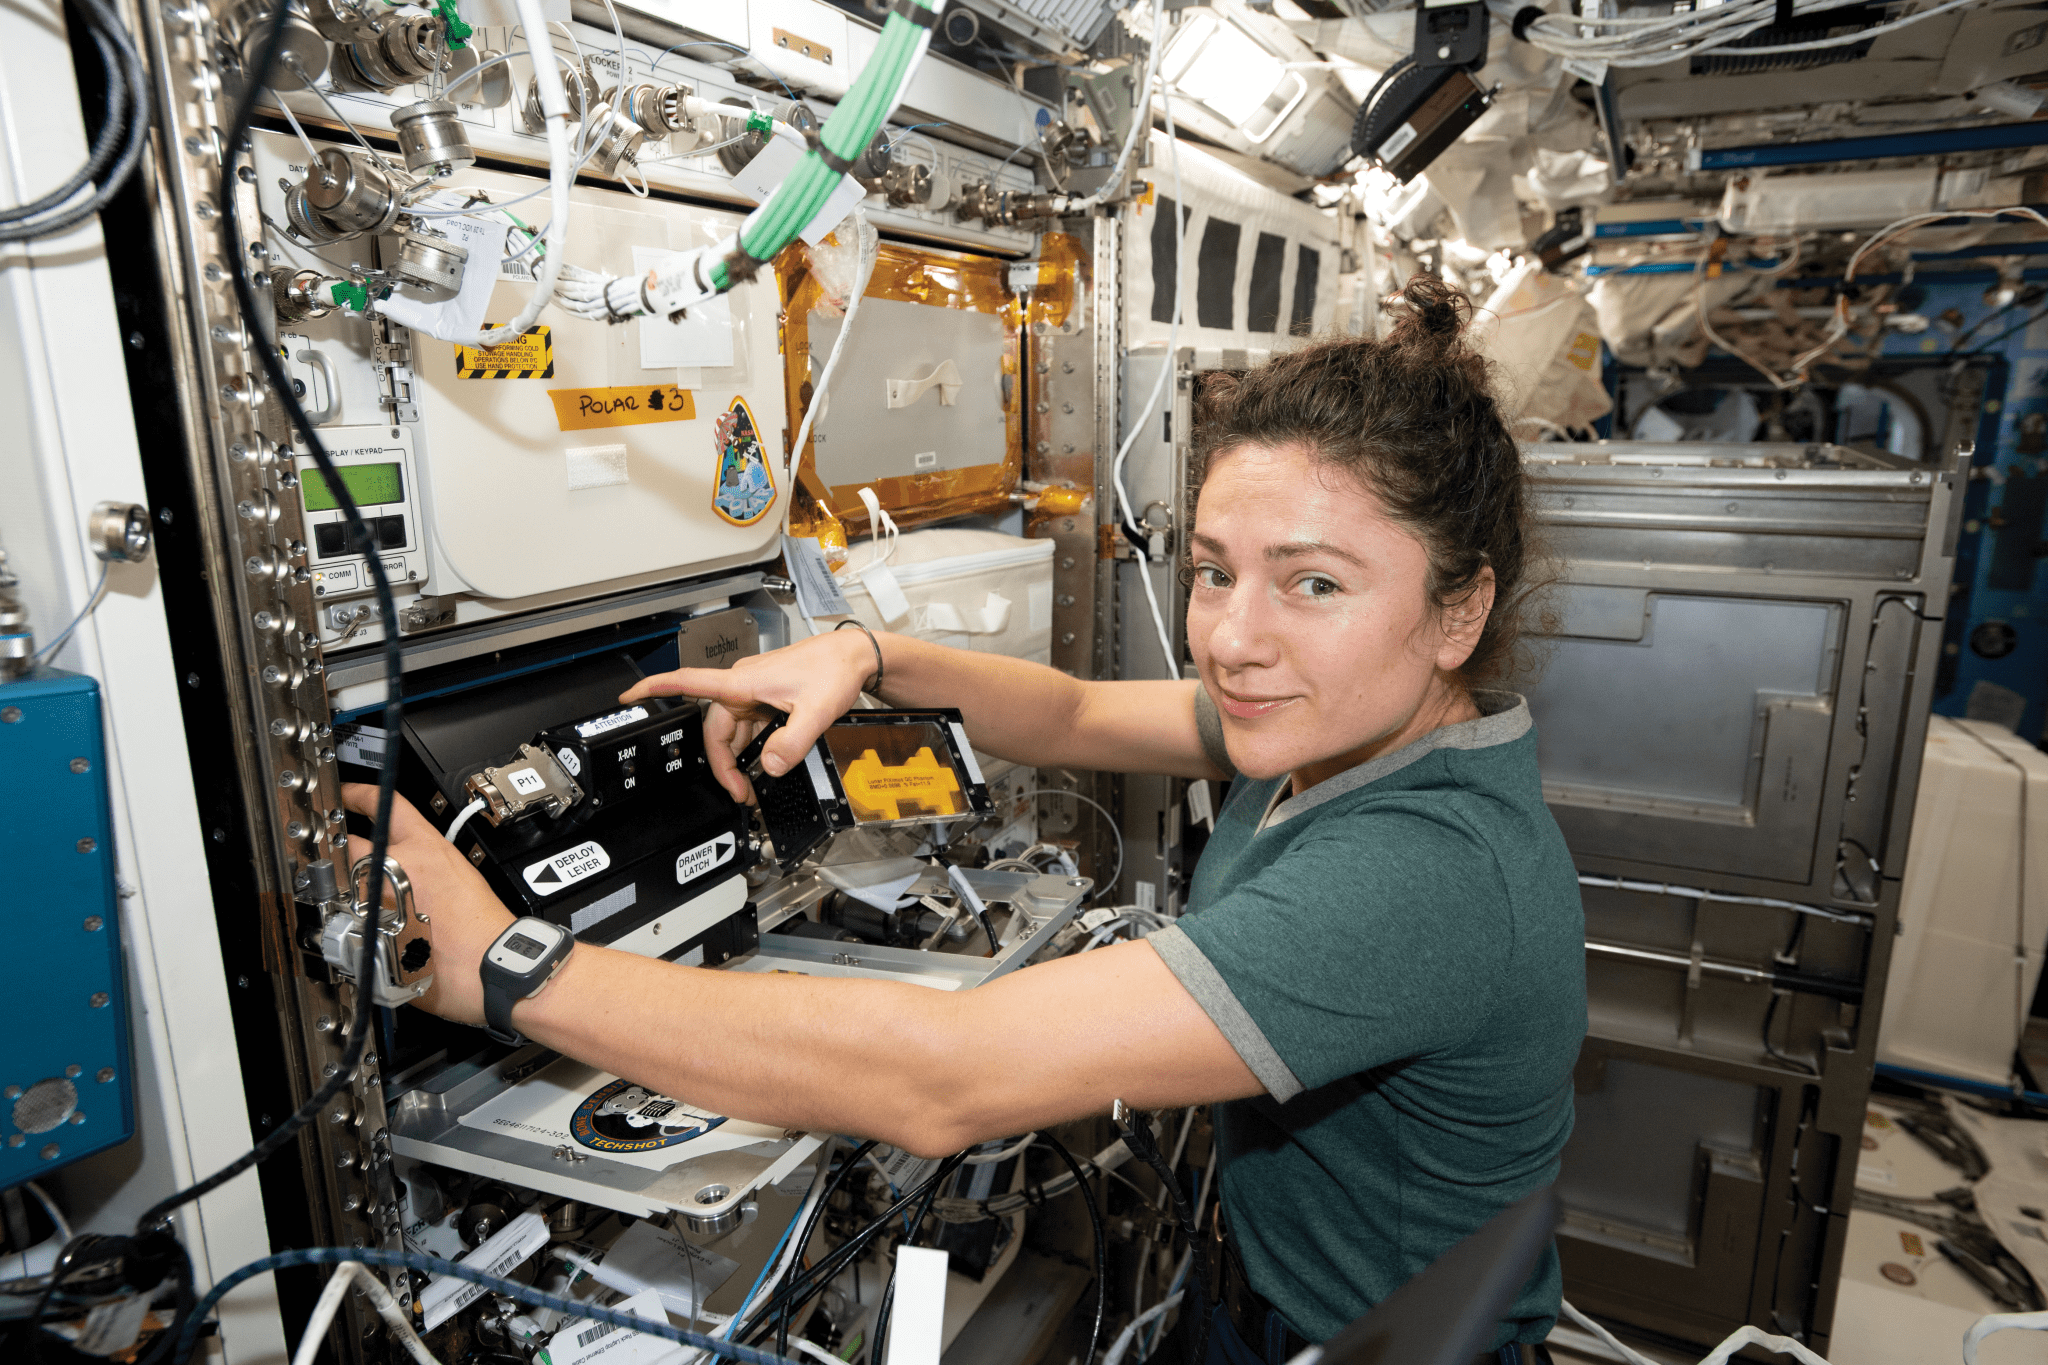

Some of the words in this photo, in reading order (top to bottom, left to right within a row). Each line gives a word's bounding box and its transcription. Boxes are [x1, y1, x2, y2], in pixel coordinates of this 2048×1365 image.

[446, 219, 462, 230] Load
[796, 341, 813, 351] LOCK
[373, 328, 386, 382] LOCKED
[579, 395, 640, 417] POLAR
[354, 447, 384, 455] KEYPAD
[383, 562, 404, 571] RROR
[328, 570, 352, 580] COMM
[705, 635, 739, 660] techshot
[594, 713, 632, 730] ATTENTION
[660, 729, 684, 747] SHUTTER
[562, 753, 578, 770] J11
[617, 746, 637, 762] X-RAY
[666, 758, 683, 773] OPEN
[516, 775, 538, 788] P11
[624, 777, 636, 790] ON
[555, 845, 596, 869] DEPLOY
[678, 845, 713, 869] DRAWER
[566, 858, 602, 879] LEVER
[683, 858, 710, 879] LATCH
[576, 1114, 591, 1137] BONE
[589, 1136, 668, 1150] TECHSHOT
[605, 1339, 621, 1350] Laptop
[620, 1333, 633, 1343] Rack
[585, 1347, 605, 1361] Ethernet
